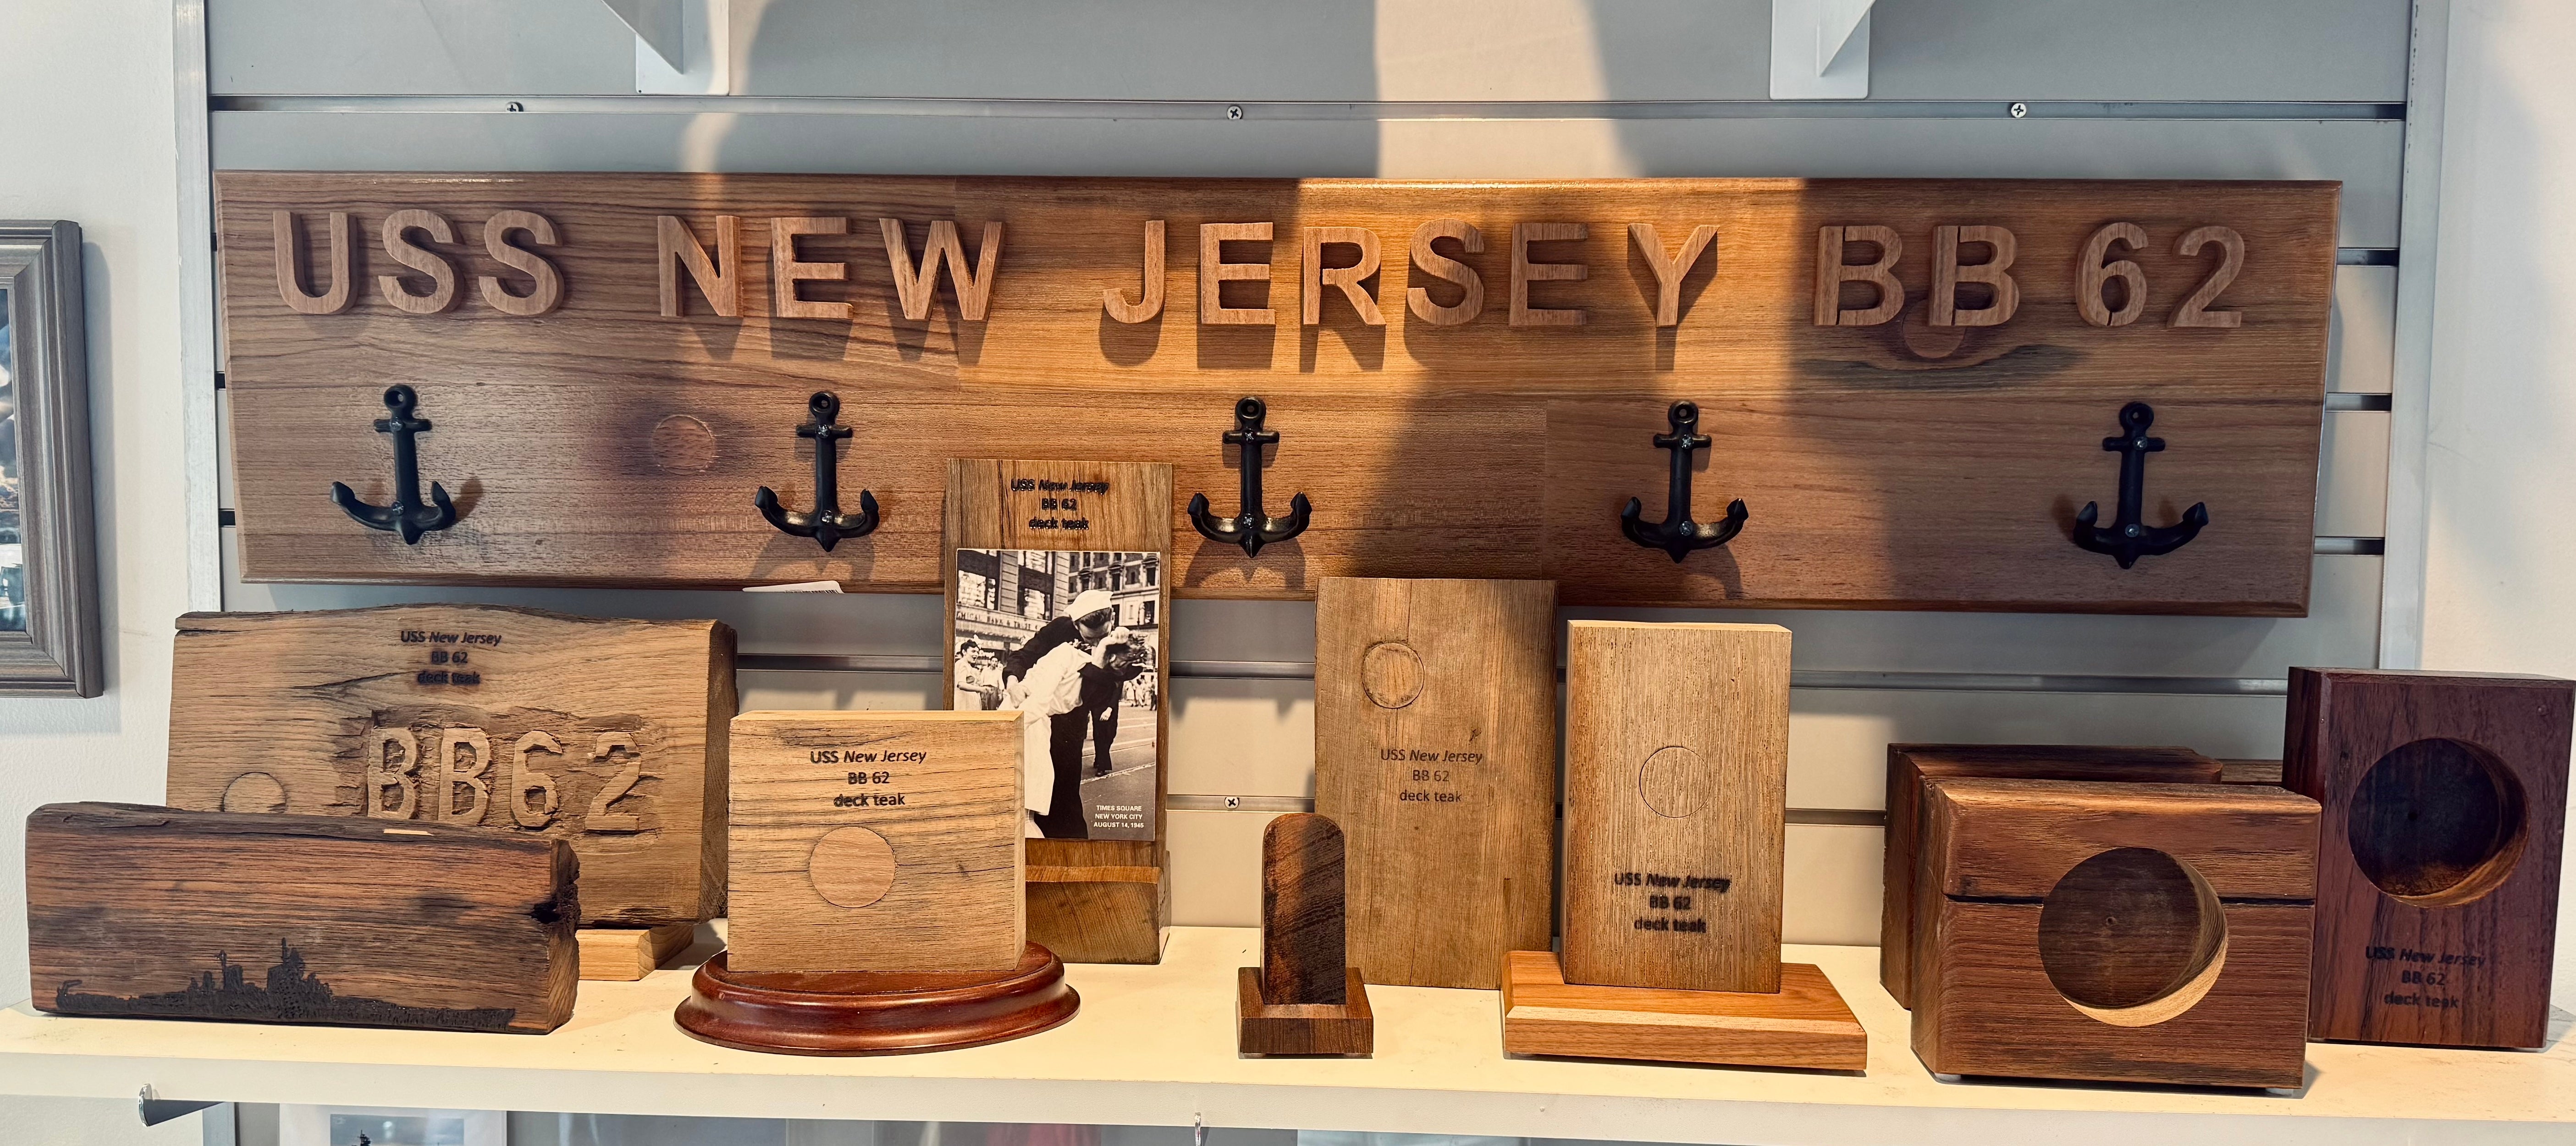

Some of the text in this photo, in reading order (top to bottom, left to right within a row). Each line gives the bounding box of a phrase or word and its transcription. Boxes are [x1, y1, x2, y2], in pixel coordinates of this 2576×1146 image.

[273, 209, 2246, 328] USS NEW JERSEY BB 62
[1011, 479, 1109, 495] USS New Jersey
[1042, 498, 1077, 511] BB 62
[1029, 516, 1089, 530] deck teak
[401, 631, 502, 647] USS New Jersey
[431, 651, 468, 663] BB 62
[417, 670, 480, 684] deck teak
[810, 750, 927, 764] USS New Jersey
[1381, 749, 1483, 765] USS New Jersey
[848, 771, 890, 784] BB 62
[1412, 770, 1450, 782] BB 62
[833, 793, 905, 807] deck teak
[1400, 790, 1462, 803] deck teak
[1615, 872, 1731, 893] USS New Jersey
[1649, 895, 1691, 909] BB 62
[1634, 917, 1706, 933] deck teak
[2366, 946, 2486, 967] USS New Jersey
[2401, 970, 2446, 986] BB 62
[2384, 991, 2459, 1008] deck teak
